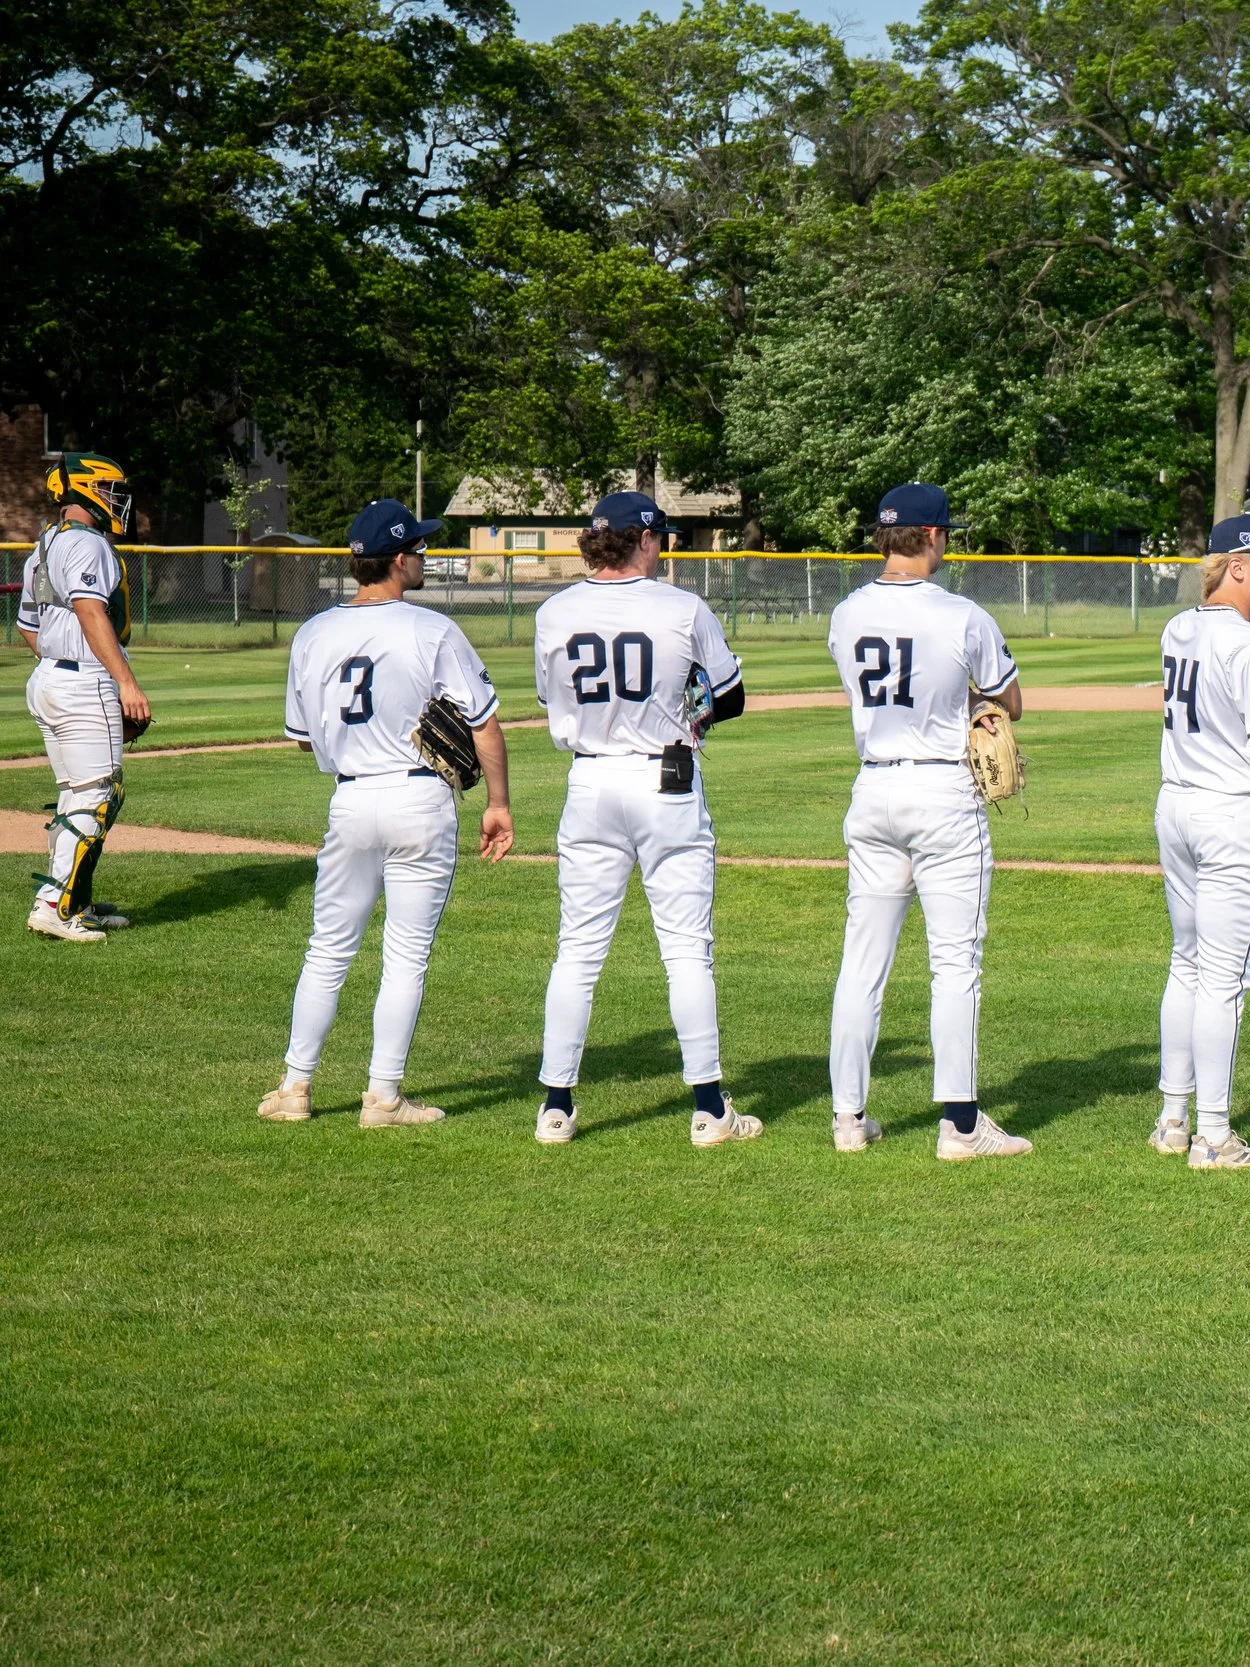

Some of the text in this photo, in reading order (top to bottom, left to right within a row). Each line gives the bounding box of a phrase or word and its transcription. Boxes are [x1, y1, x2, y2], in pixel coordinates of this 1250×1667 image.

[340, 656, 374, 725] 3
[567, 633, 652, 704] 20
[855, 637, 914, 708] 21
